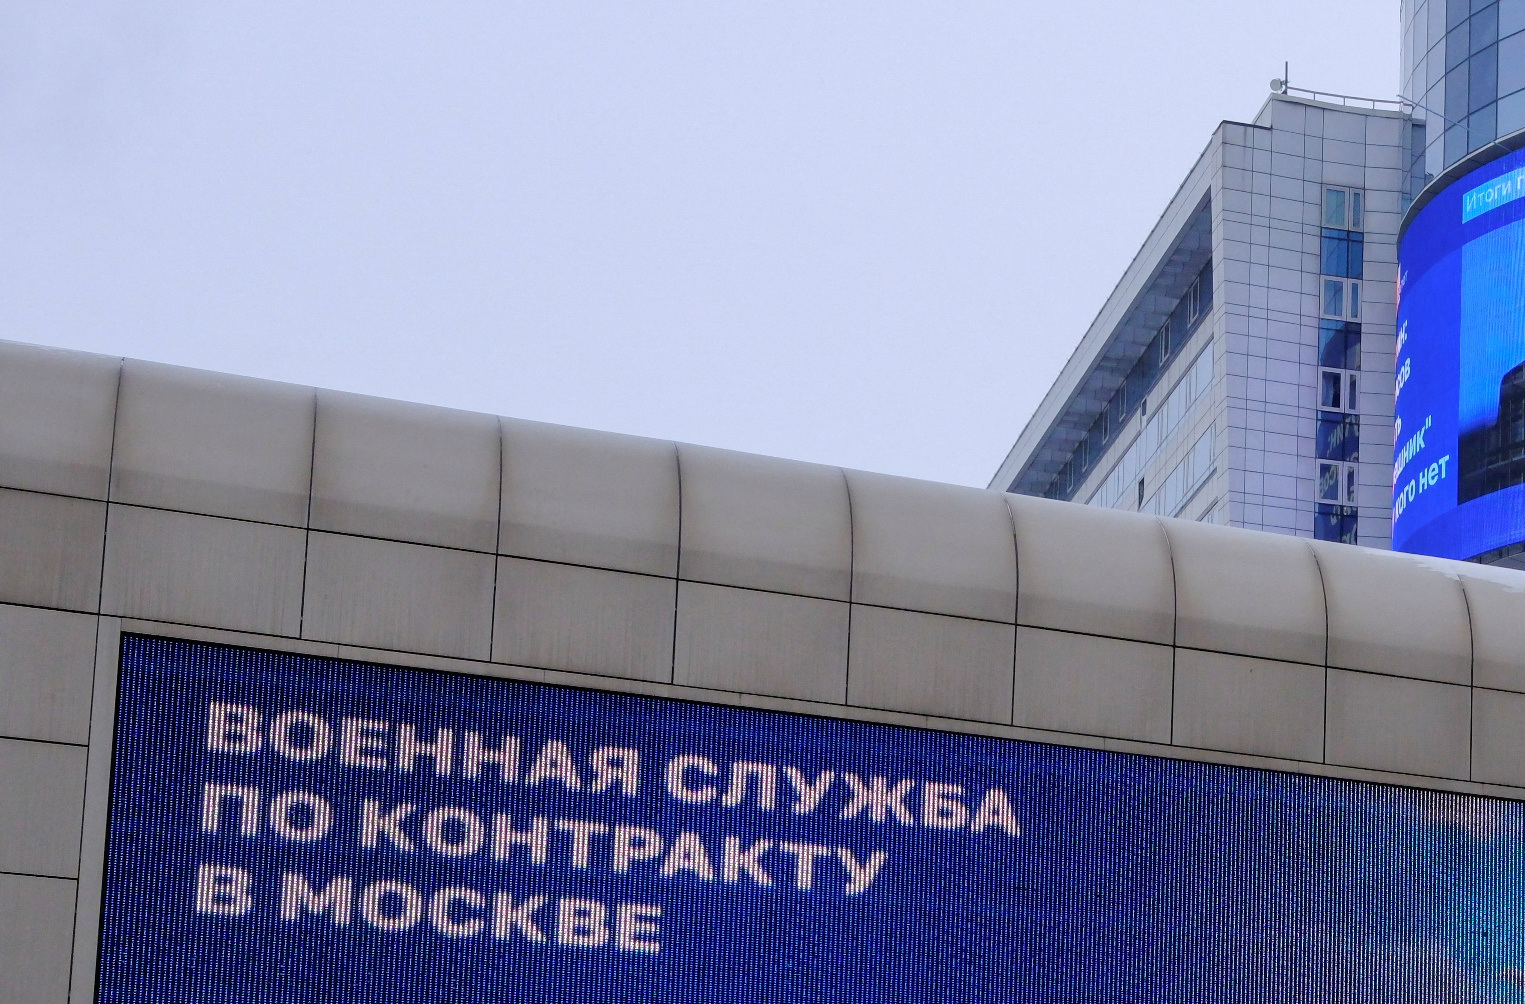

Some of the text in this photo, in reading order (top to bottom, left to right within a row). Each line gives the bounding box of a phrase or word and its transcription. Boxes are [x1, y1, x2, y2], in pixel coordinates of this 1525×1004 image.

[1466, 180, 1512, 213] Итоги
[1419, 454, 1450, 494] нет
[206, 702, 1022, 838] ВОЕННАЯ СЛУЖБА
[201, 782, 890, 897] ПО КОНТРАКТУ
[194, 864, 663, 956] В МОСКВЕ
